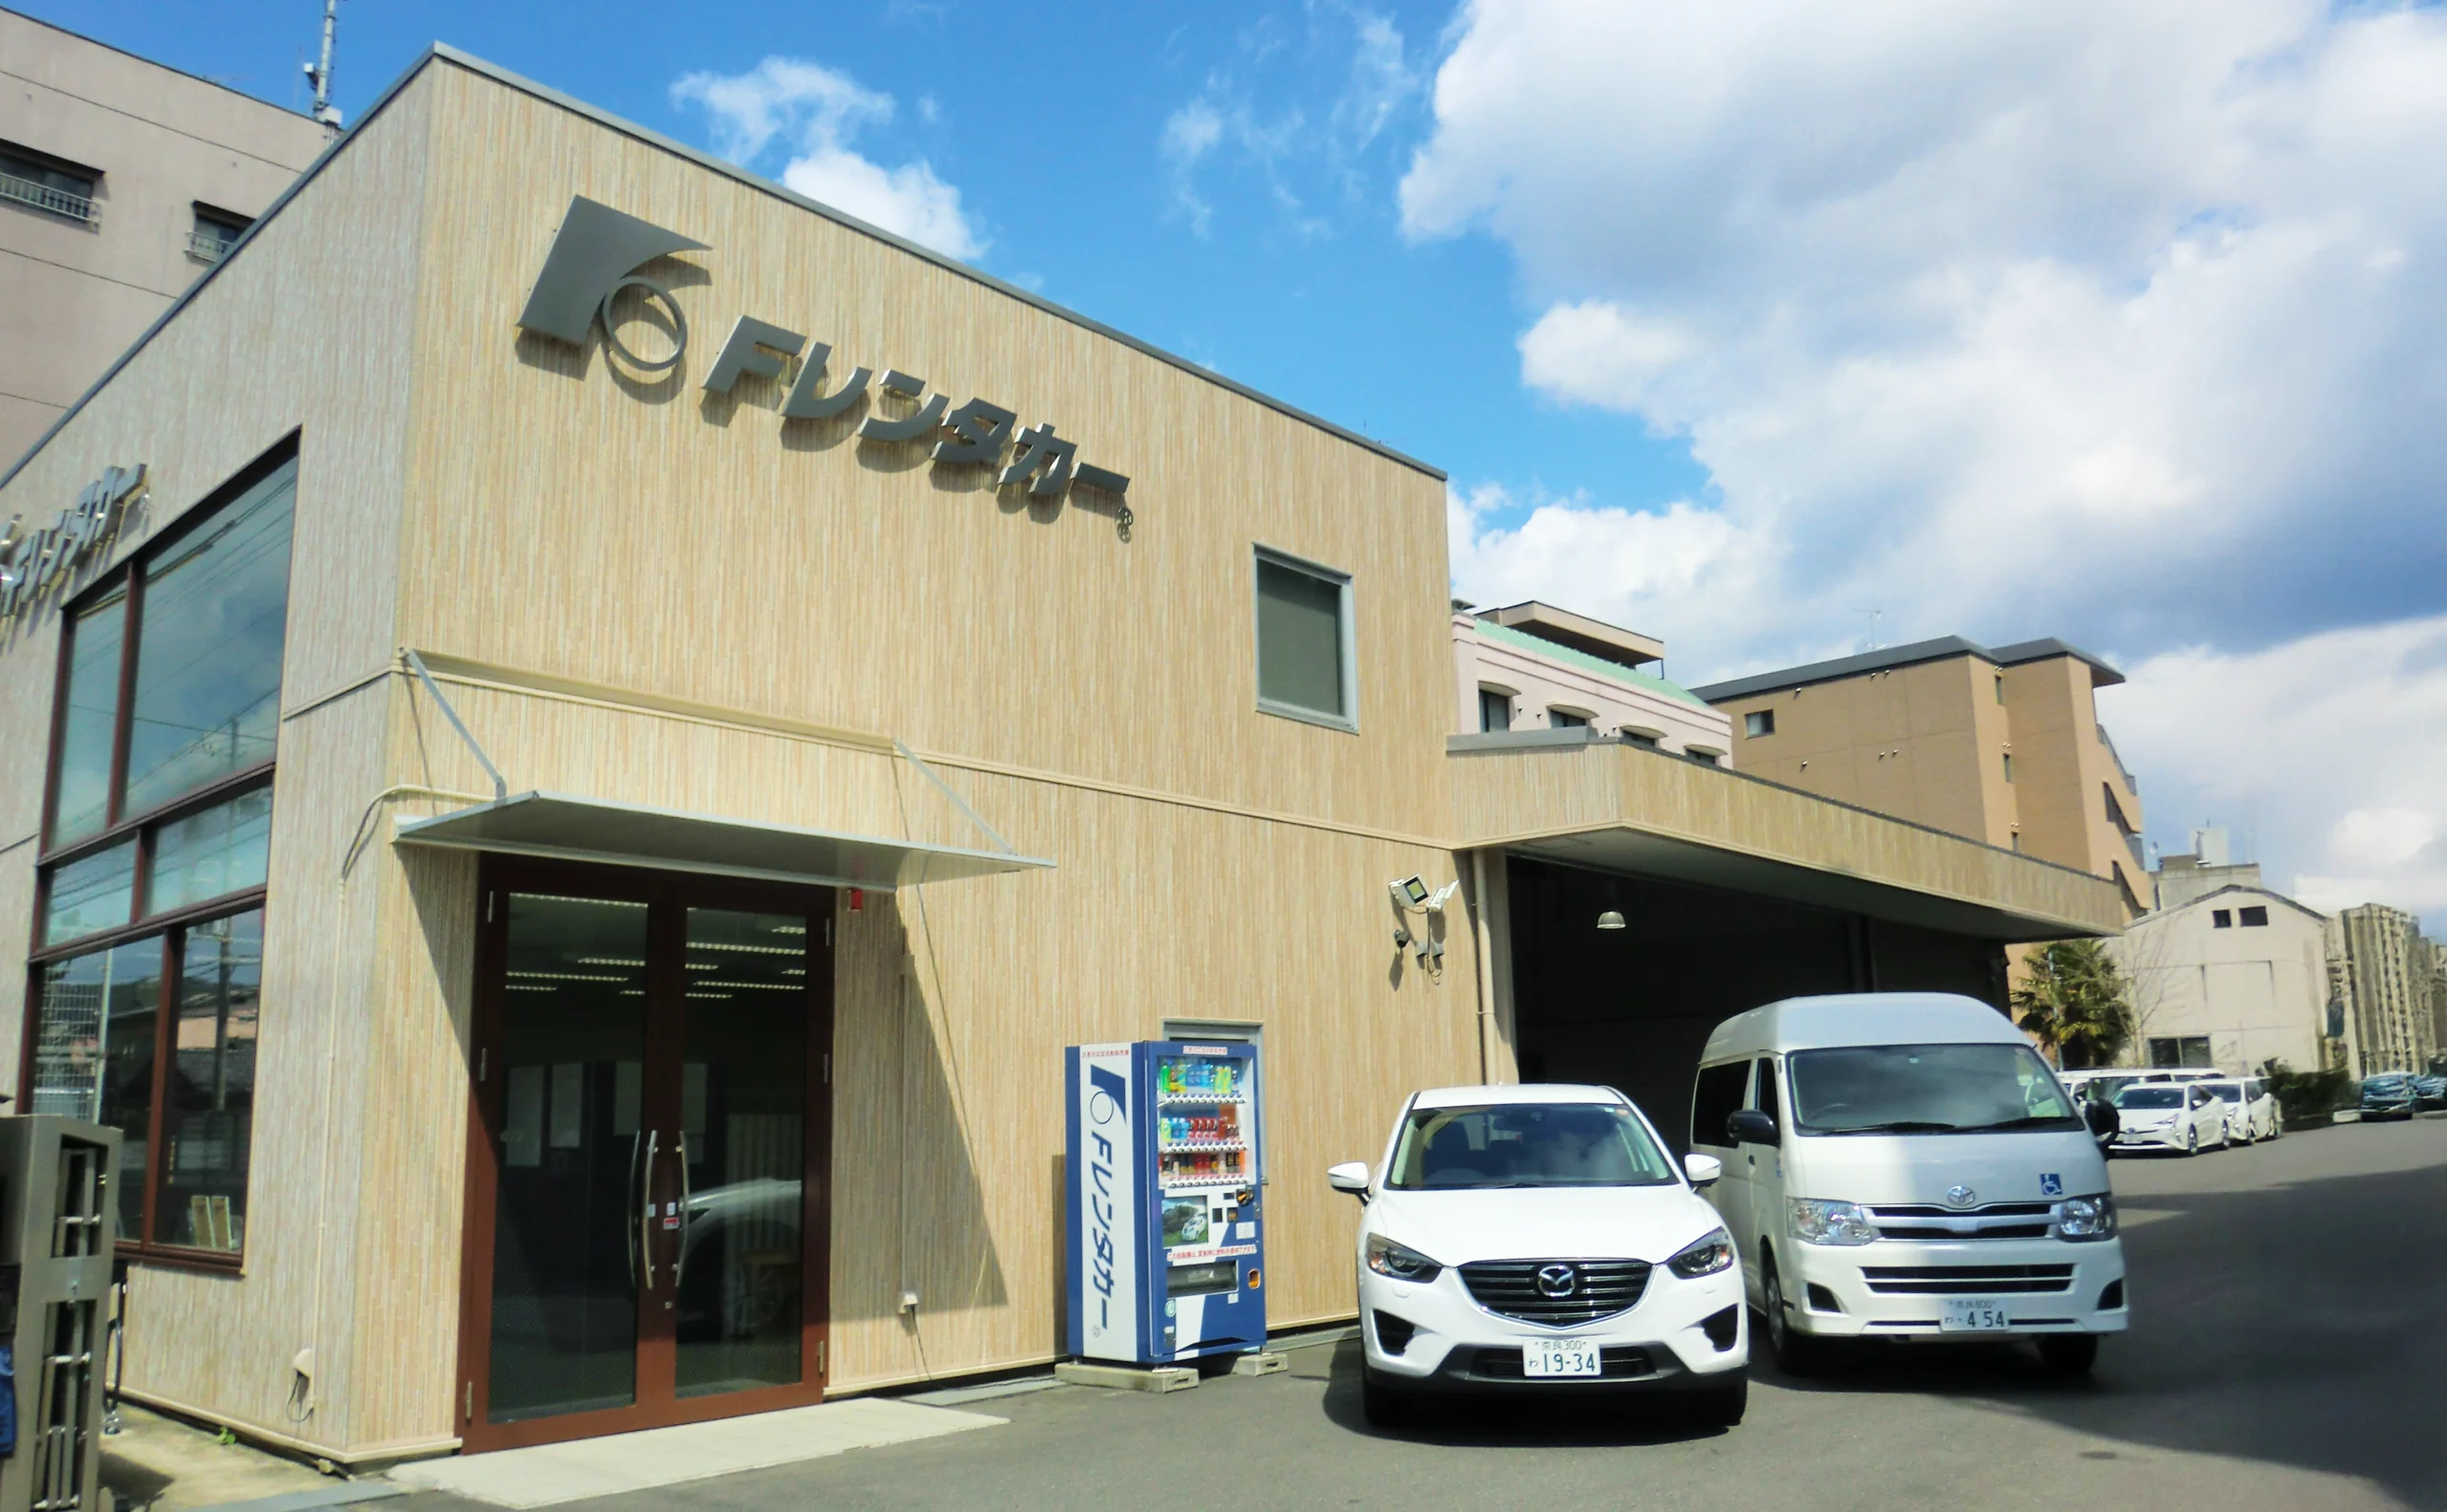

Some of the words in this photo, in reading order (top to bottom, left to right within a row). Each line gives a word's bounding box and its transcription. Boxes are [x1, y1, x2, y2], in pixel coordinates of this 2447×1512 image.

[701, 314, 1130, 494] Fレンタカー
[1091, 1130, 1115, 1329] Fレンタカー
[1544, 1352, 1595, 1372] 19-34
